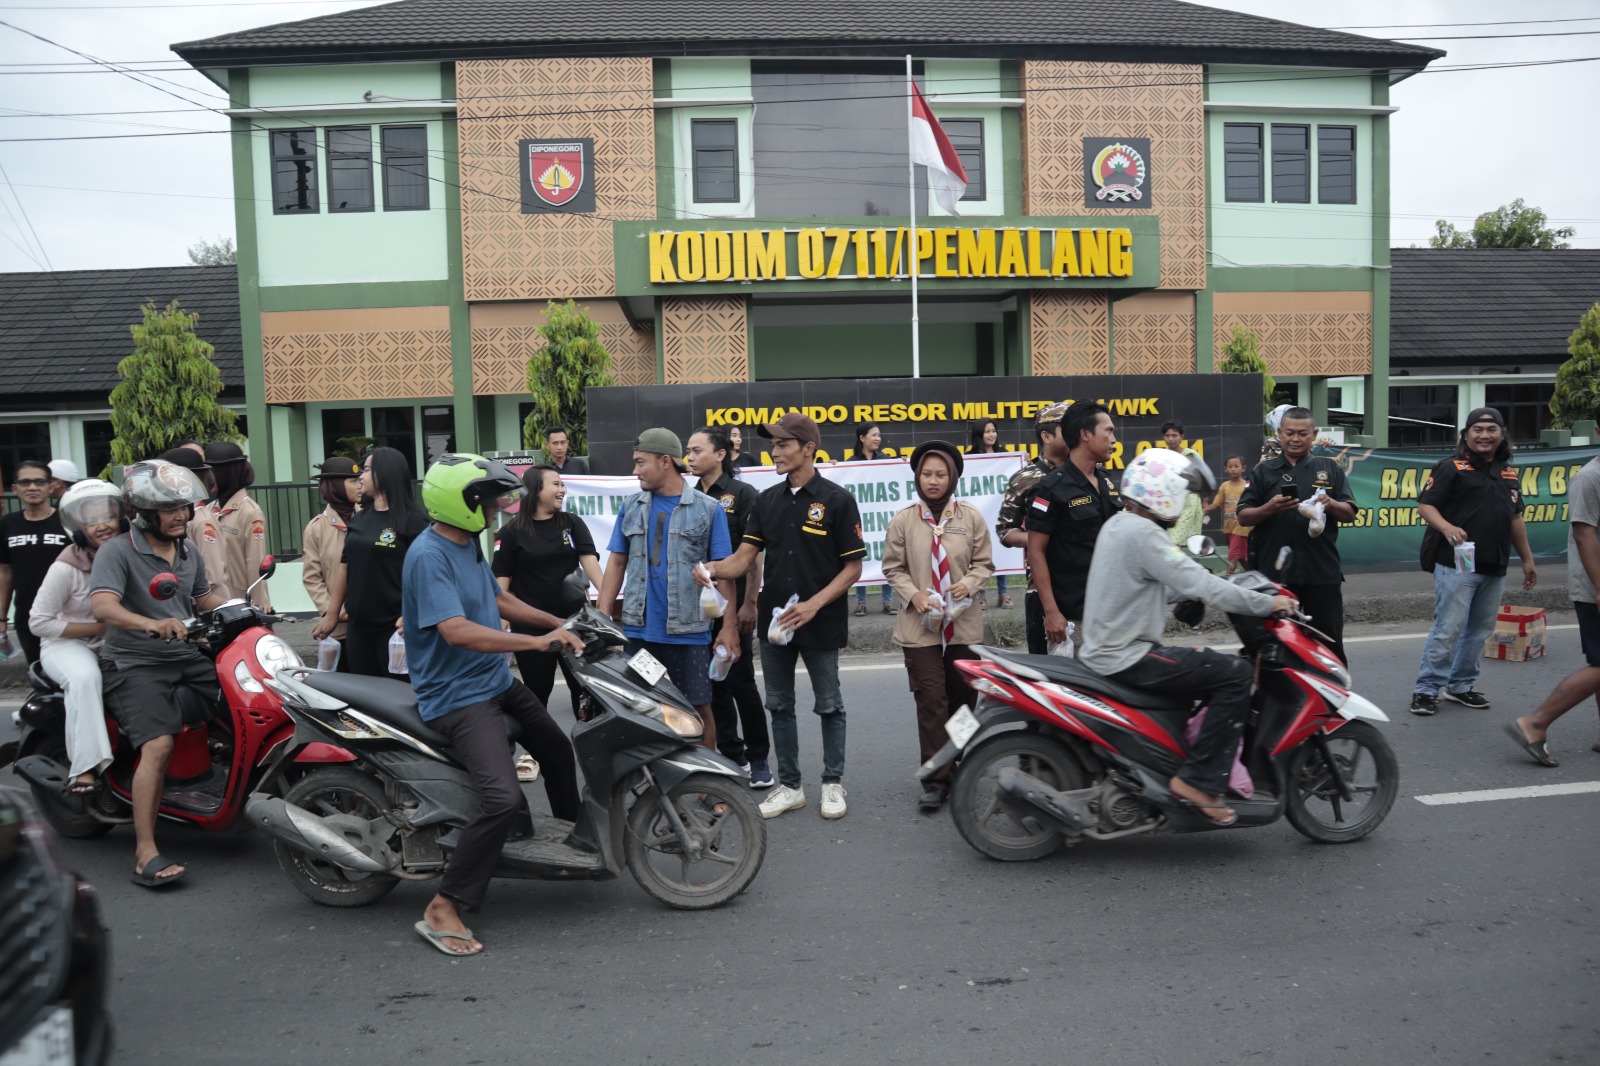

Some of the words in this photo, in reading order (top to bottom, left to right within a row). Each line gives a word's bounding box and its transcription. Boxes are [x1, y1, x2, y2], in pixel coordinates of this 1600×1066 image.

[531, 145, 580, 153] DIPONEGORO
[649, 230, 787, 283] KODIM
[797, 226, 1133, 280] 0711/PEMALANG
[854, 403, 947, 423] RESOR
[565, 496, 603, 515] AMI
[8, 534, 38, 548] 234
[43, 533, 66, 546] SC
